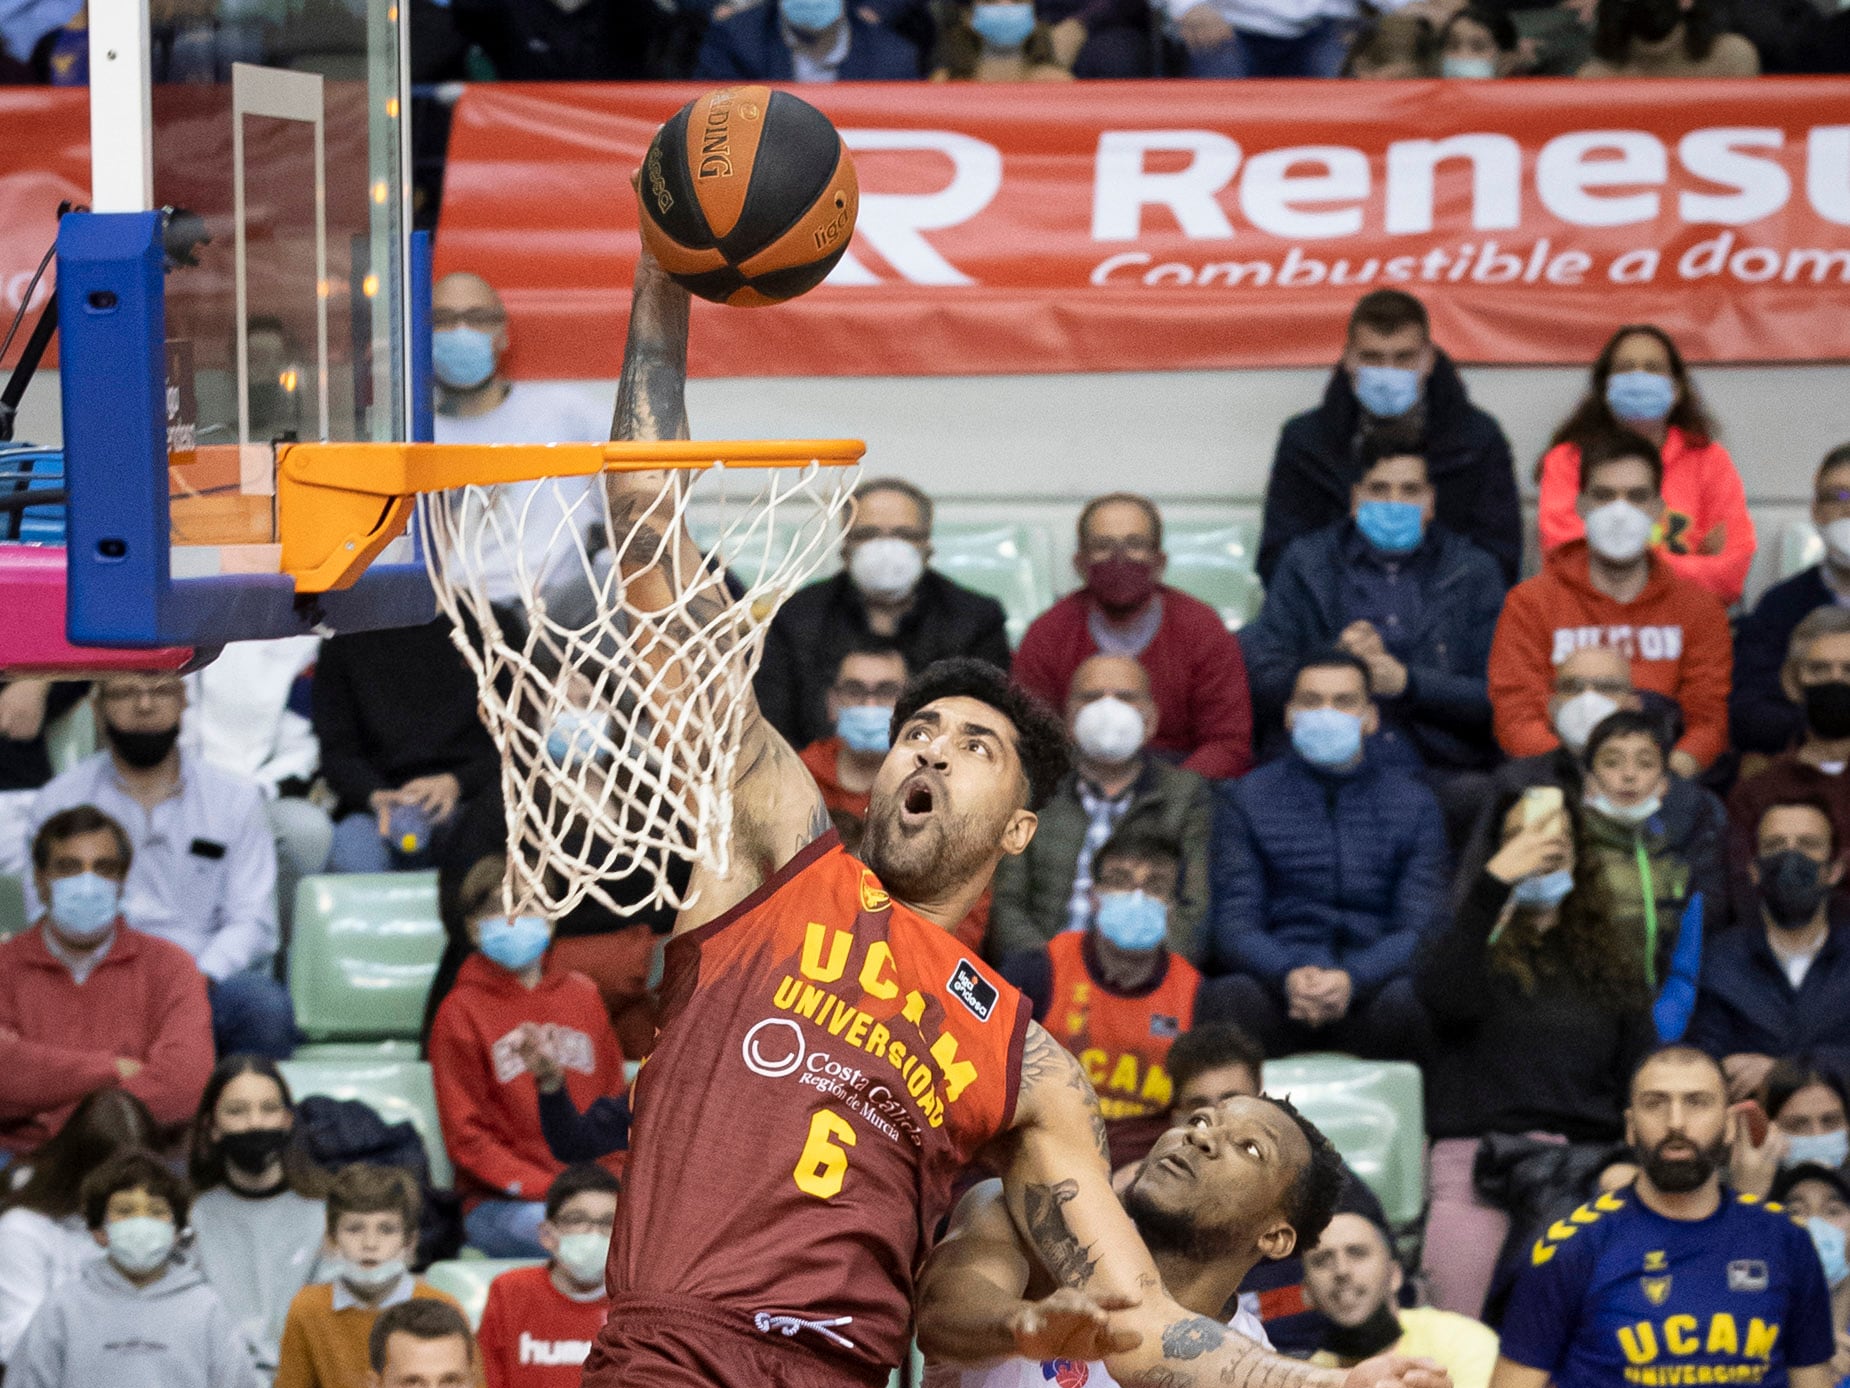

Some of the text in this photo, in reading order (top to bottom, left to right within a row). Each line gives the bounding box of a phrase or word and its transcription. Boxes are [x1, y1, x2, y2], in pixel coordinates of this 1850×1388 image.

[812, 209, 849, 251] liga
[1090, 239, 1593, 286] Combustible
[1608, 249, 1660, 284] a
[954, 980, 988, 1017] endesa
[958, 969, 975, 992] liga
[806, 1051, 870, 1093] Costa
[1080, 1048, 1173, 1107] CAM
[799, 1071, 901, 1143] Región de Murcia
[792, 1108, 857, 1200] 6
[1616, 1311, 1779, 1365] UCAM
